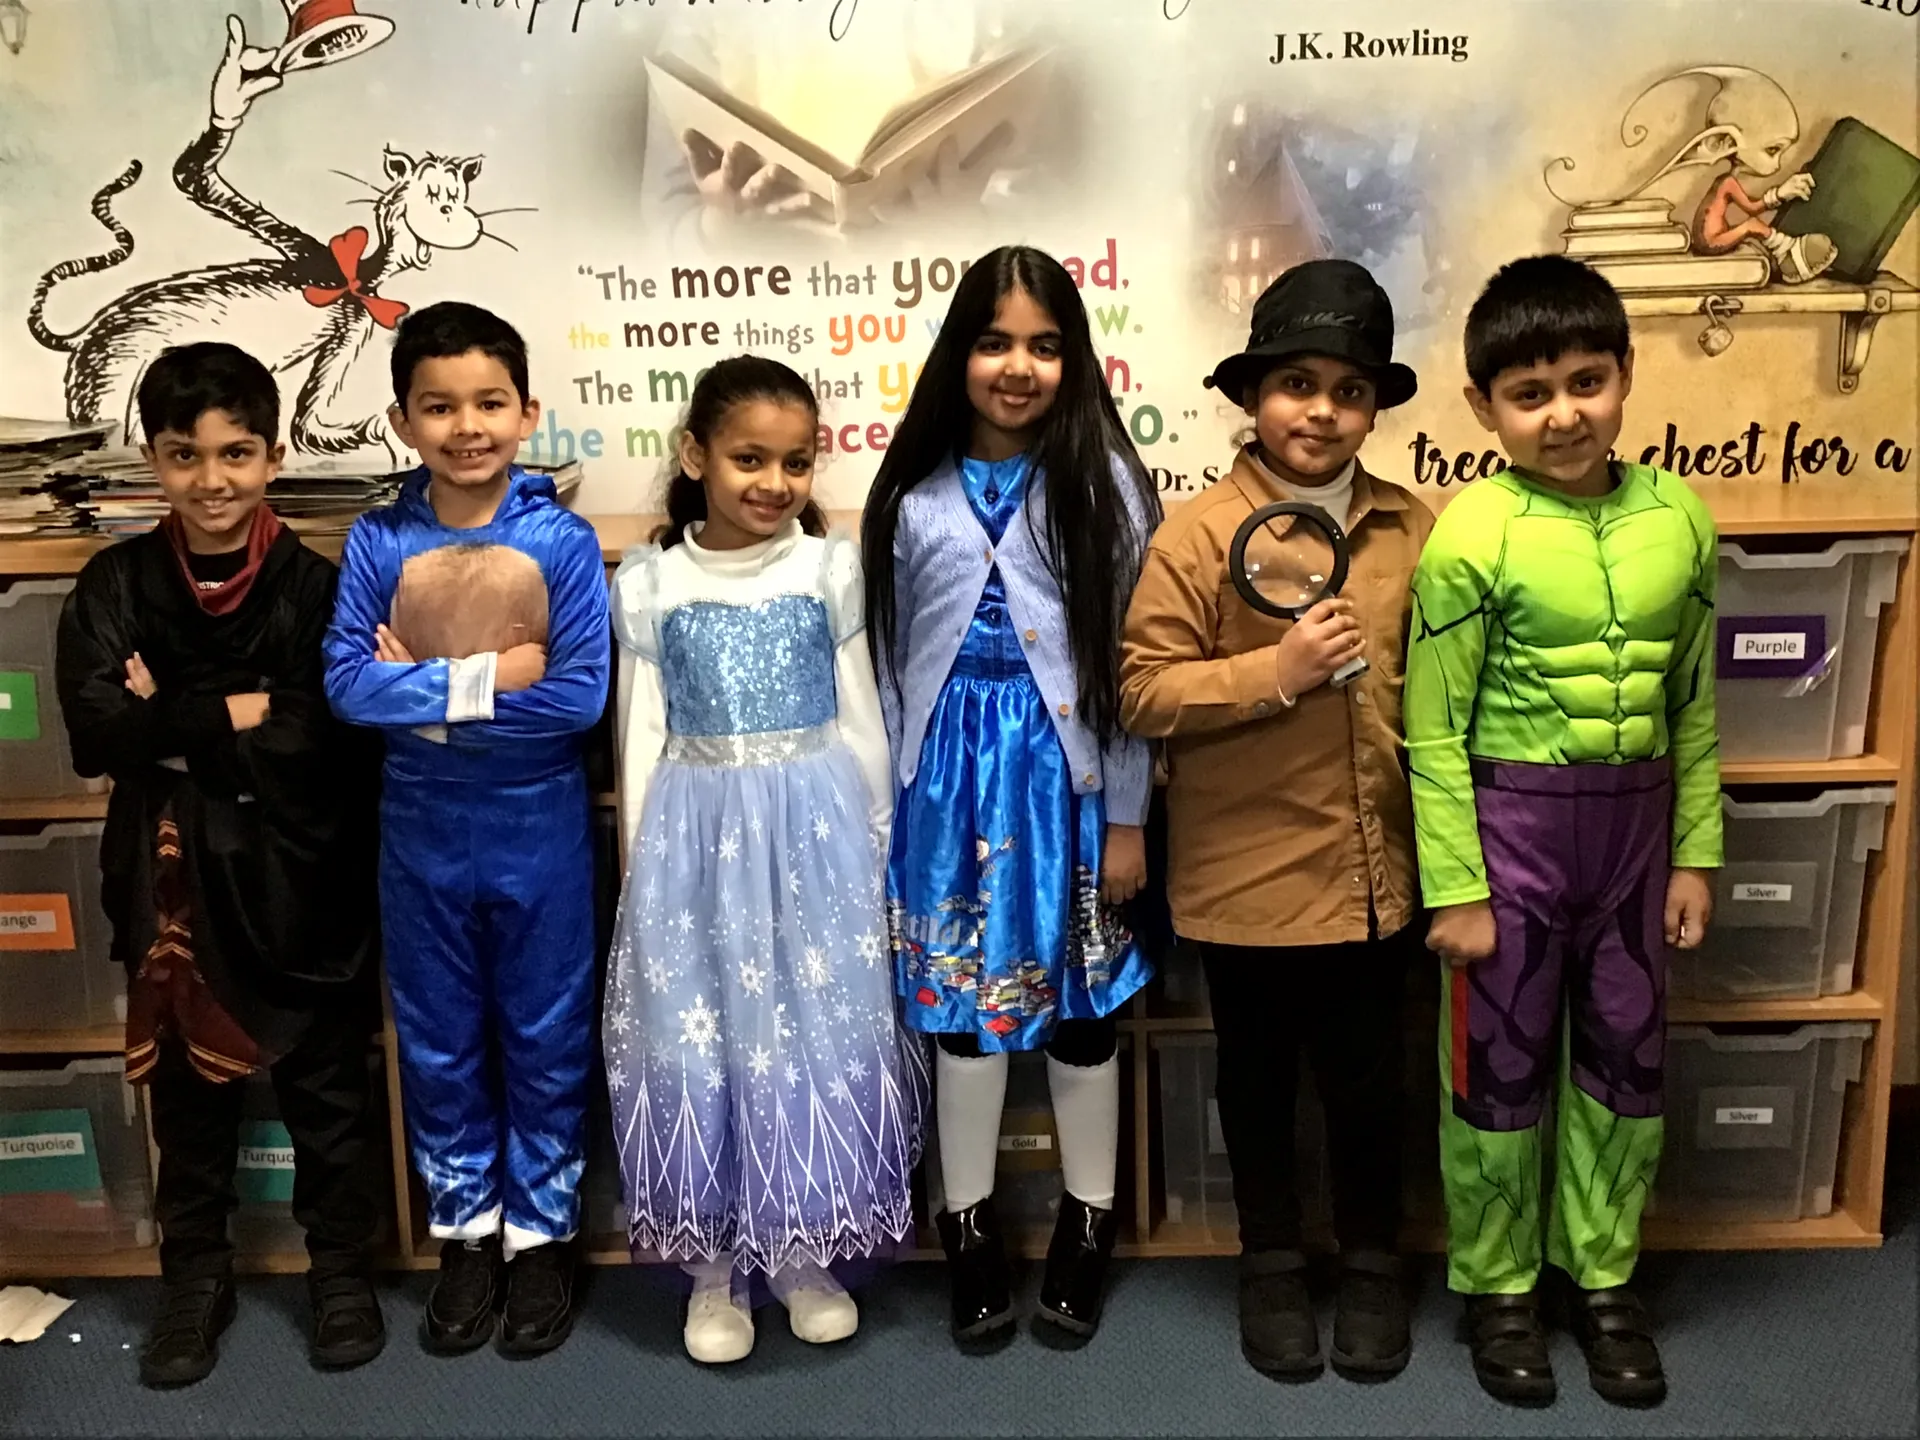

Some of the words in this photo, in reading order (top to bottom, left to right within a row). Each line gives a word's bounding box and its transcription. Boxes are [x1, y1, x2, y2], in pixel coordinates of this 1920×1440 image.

[1269, 33, 1333, 64] J.K.
[1342, 28, 1469, 62] Rowling
[671, 265, 791, 299] more
[807, 260, 877, 297] that
[893, 257, 970, 309] yo
[1062, 238, 1129, 290] ad,
[568, 322, 611, 349] the
[624, 321, 720, 348] more
[733, 318, 814, 355] things
[829, 314, 906, 356] you
[572, 370, 633, 405] The
[816, 422, 890, 454] ace
[1782, 421, 1858, 483] for
[1875, 439, 1912, 472] a
[1151, 468, 1194, 492] Dr.
[1745, 639, 1797, 656] Purple
[1746, 887, 1777, 898] Silver
[0, 915, 37, 929] ange
[1730, 1111, 1758, 1121] Silver
[2, 1137, 76, 1154] Turquoise
[1012, 1137, 1037, 1148] Gold
[242, 1149, 295, 1165] Turquo
